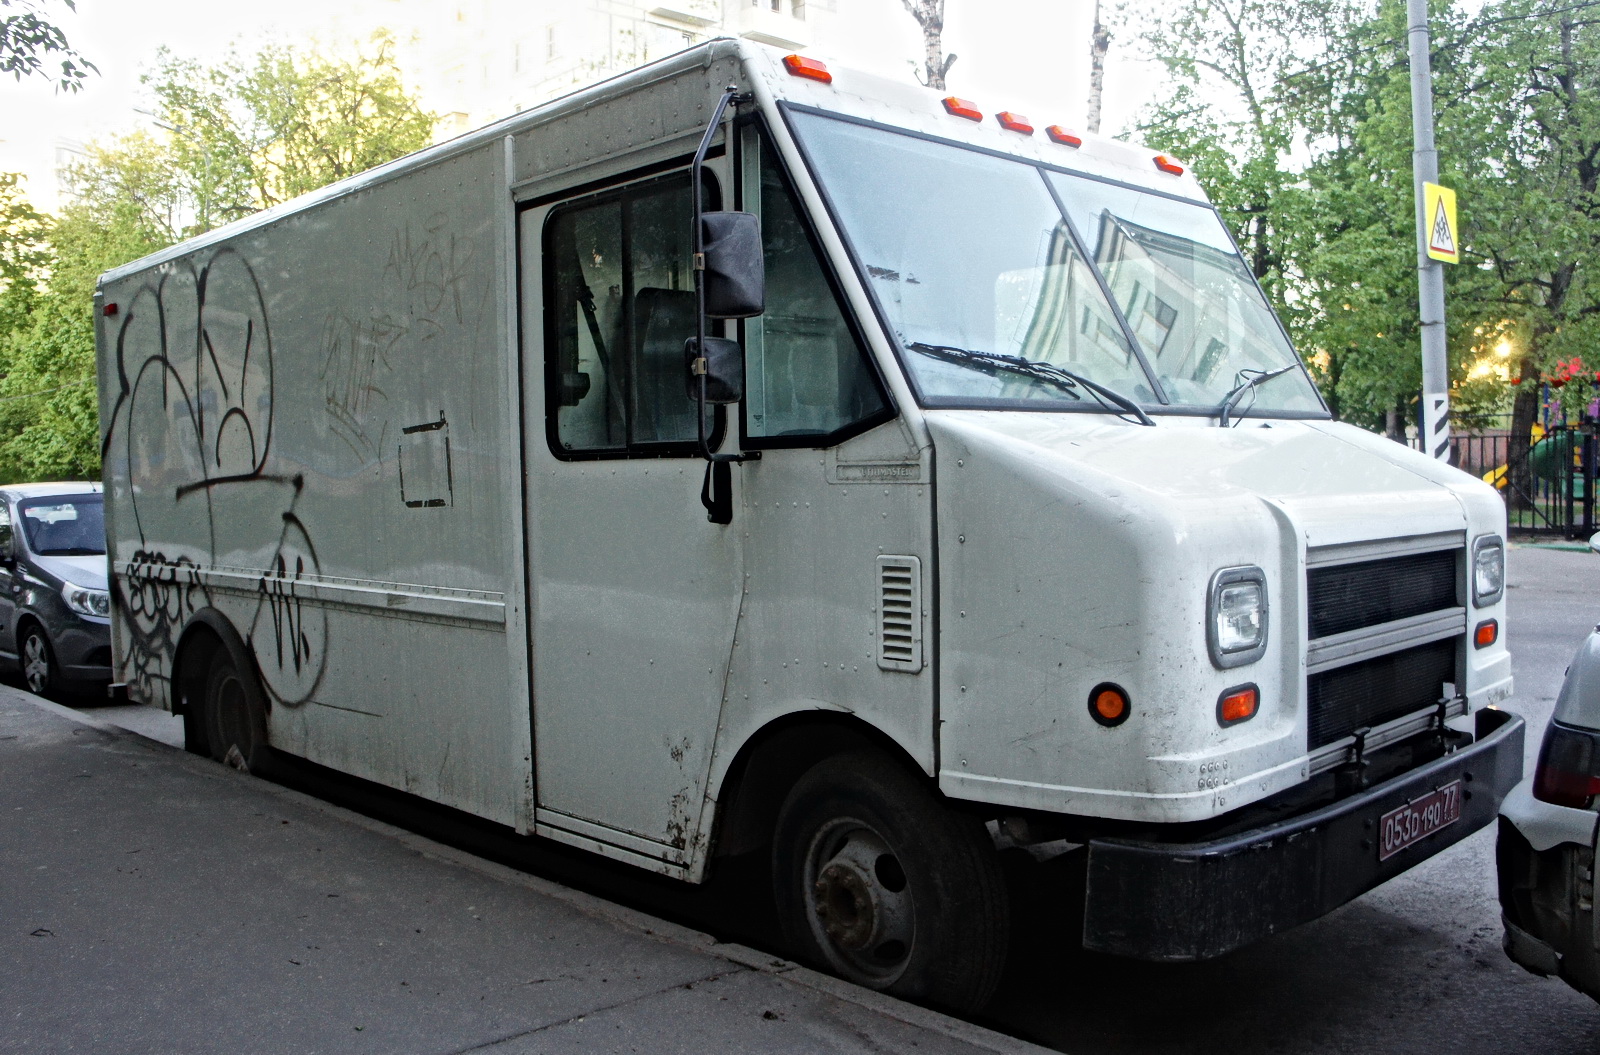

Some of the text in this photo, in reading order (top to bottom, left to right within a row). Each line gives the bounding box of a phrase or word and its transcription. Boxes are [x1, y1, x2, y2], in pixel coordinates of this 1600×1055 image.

[1385, 785, 1456, 851] 053D 190 77
